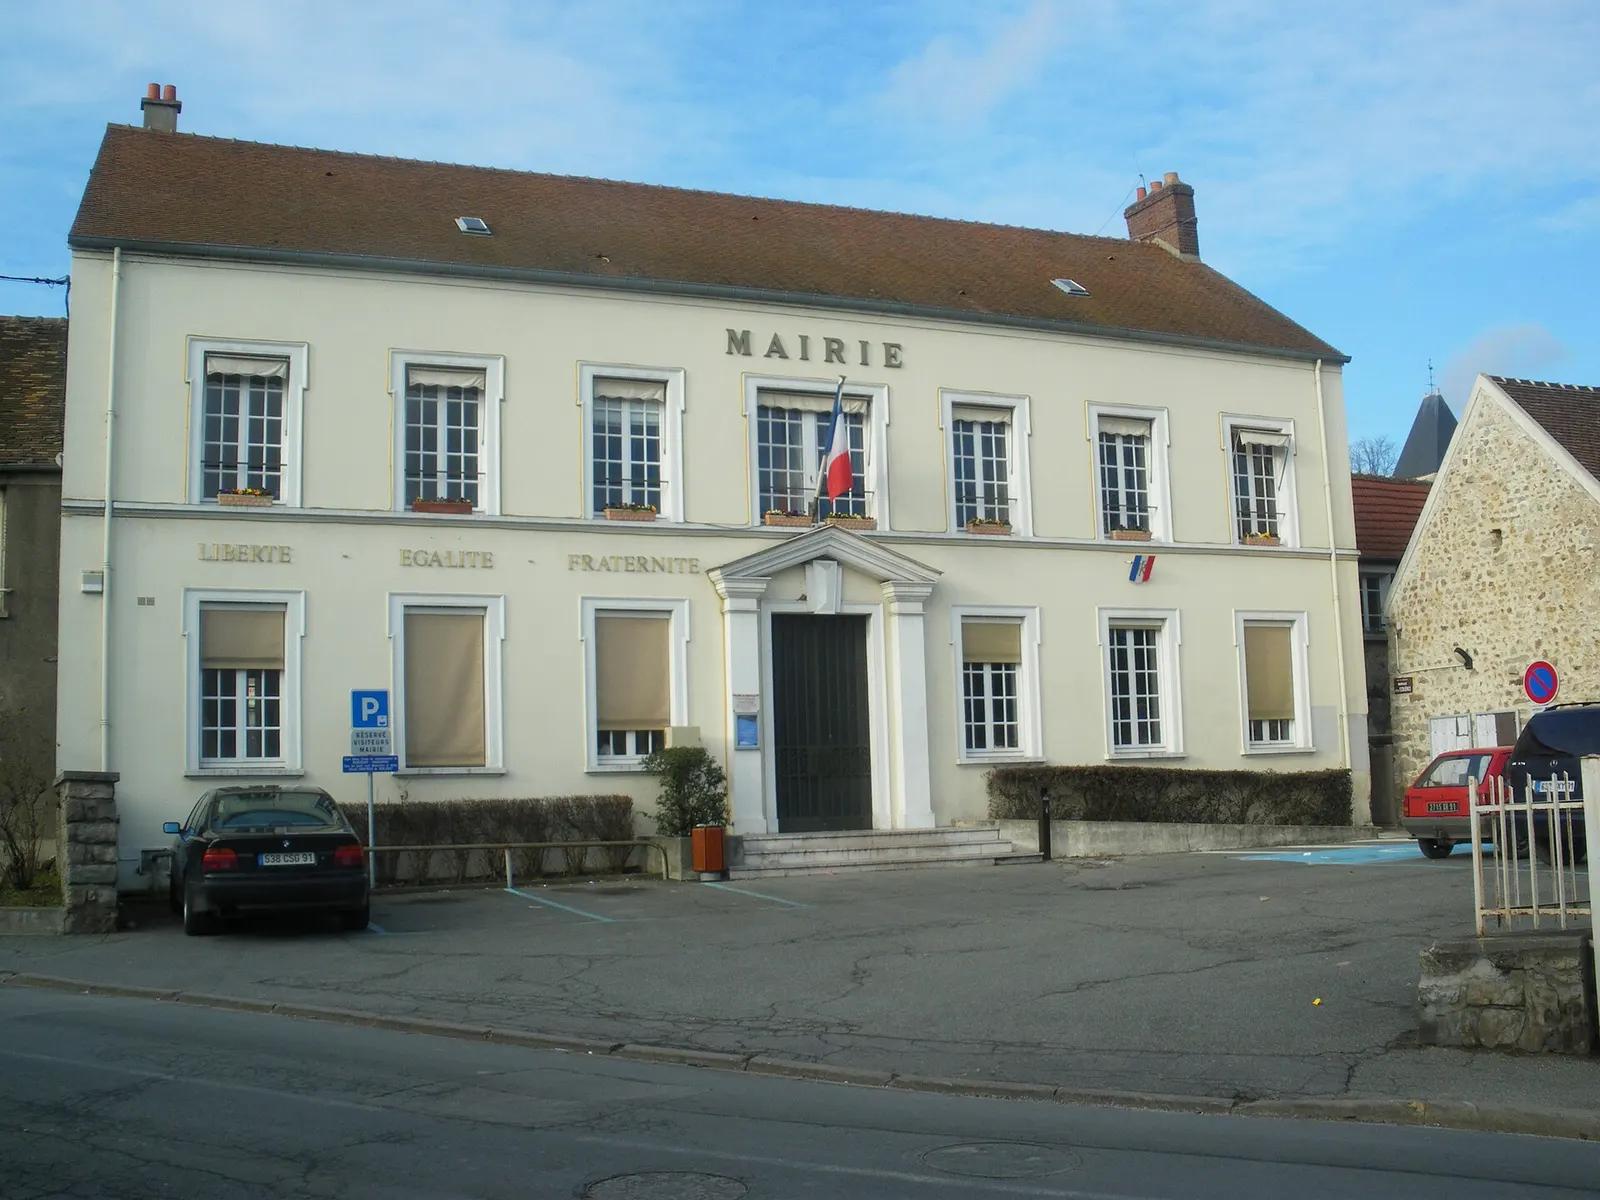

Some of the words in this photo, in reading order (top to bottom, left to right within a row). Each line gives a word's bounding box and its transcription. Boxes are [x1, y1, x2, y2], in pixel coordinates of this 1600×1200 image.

[725, 328, 903, 368] MAIRIE
[198, 542, 292, 564] LIBERTE
[399, 548, 494, 570] EGALITE
[567, 553, 700, 575] FRATERNITE
[361, 697, 379, 721] P
[264, 854, 281, 864] 538
[283, 853, 300, 863] CSG
[302, 853, 313, 863] 91
